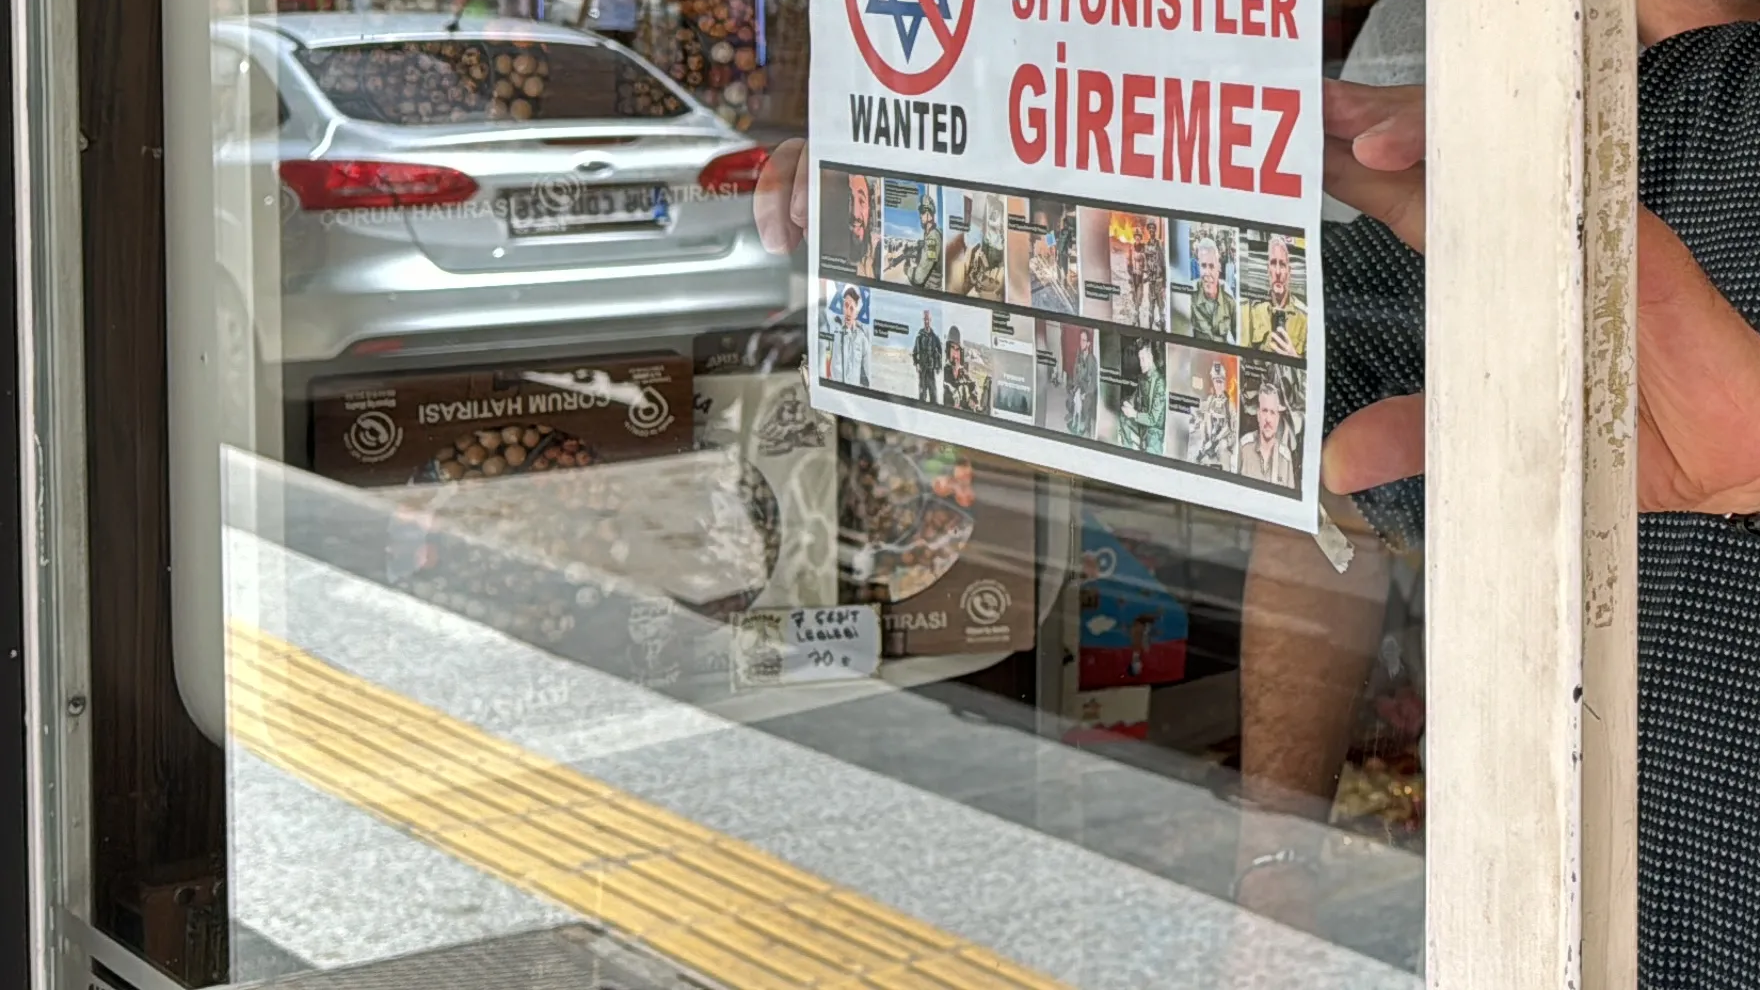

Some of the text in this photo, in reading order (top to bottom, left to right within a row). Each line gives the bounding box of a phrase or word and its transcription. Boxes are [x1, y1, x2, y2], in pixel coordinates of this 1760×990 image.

[850, 94, 967, 155] WANTED
[1009, 41, 1302, 198] GİREMEZ
[320, 204, 404, 231] ÇORUM
[418, 394, 522, 424] HATIRASI
